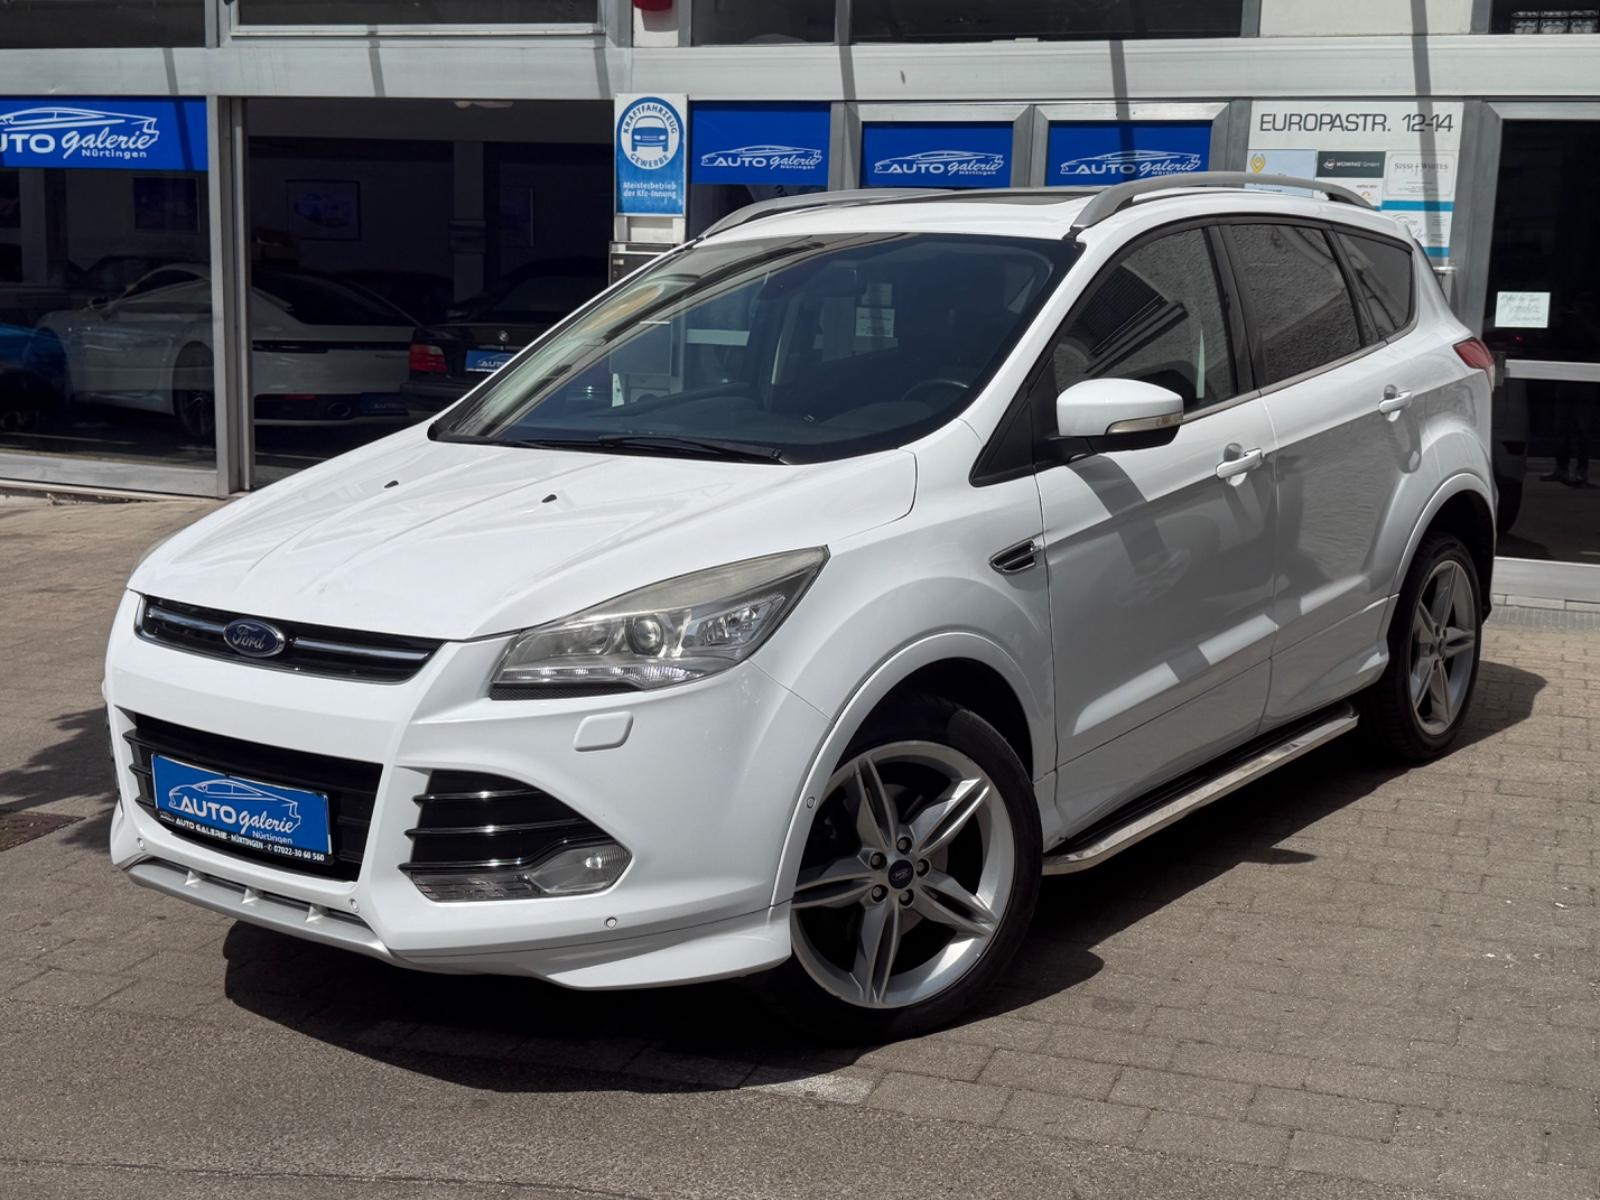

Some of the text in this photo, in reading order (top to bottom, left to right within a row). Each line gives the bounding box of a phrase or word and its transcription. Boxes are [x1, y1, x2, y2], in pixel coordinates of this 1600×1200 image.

[623, 104, 678, 134] KRAFTFAHRZEUG
[1259, 113, 1454, 133] EUROPASTR. 12-14
[61, 126, 155, 160] galerie
[81, 149, 147, 159] Nürtingen
[630, 153, 670, 169] GEWERBE
[714, 154, 819, 170] AUTO galerie
[888, 160, 1001, 176] AUTO galerie
[1075, 163, 1137, 174] AUTO
[1139, 160, 1197, 176] galerie
[637, 190, 677, 199] Kfz-Innung
[480, 360, 505, 368] AUT
[232, 624, 265, 649] Ford
[180, 795, 297, 834] AUTO galerie
[175, 817, 195, 830] AUTO
[195, 822, 228, 840] GALERIE
[273, 845, 302, 858] 07022-30
[303, 851, 311, 859] 60
[312, 853, 325, 862] 560
[252, 830, 293, 845] Nürtingen
